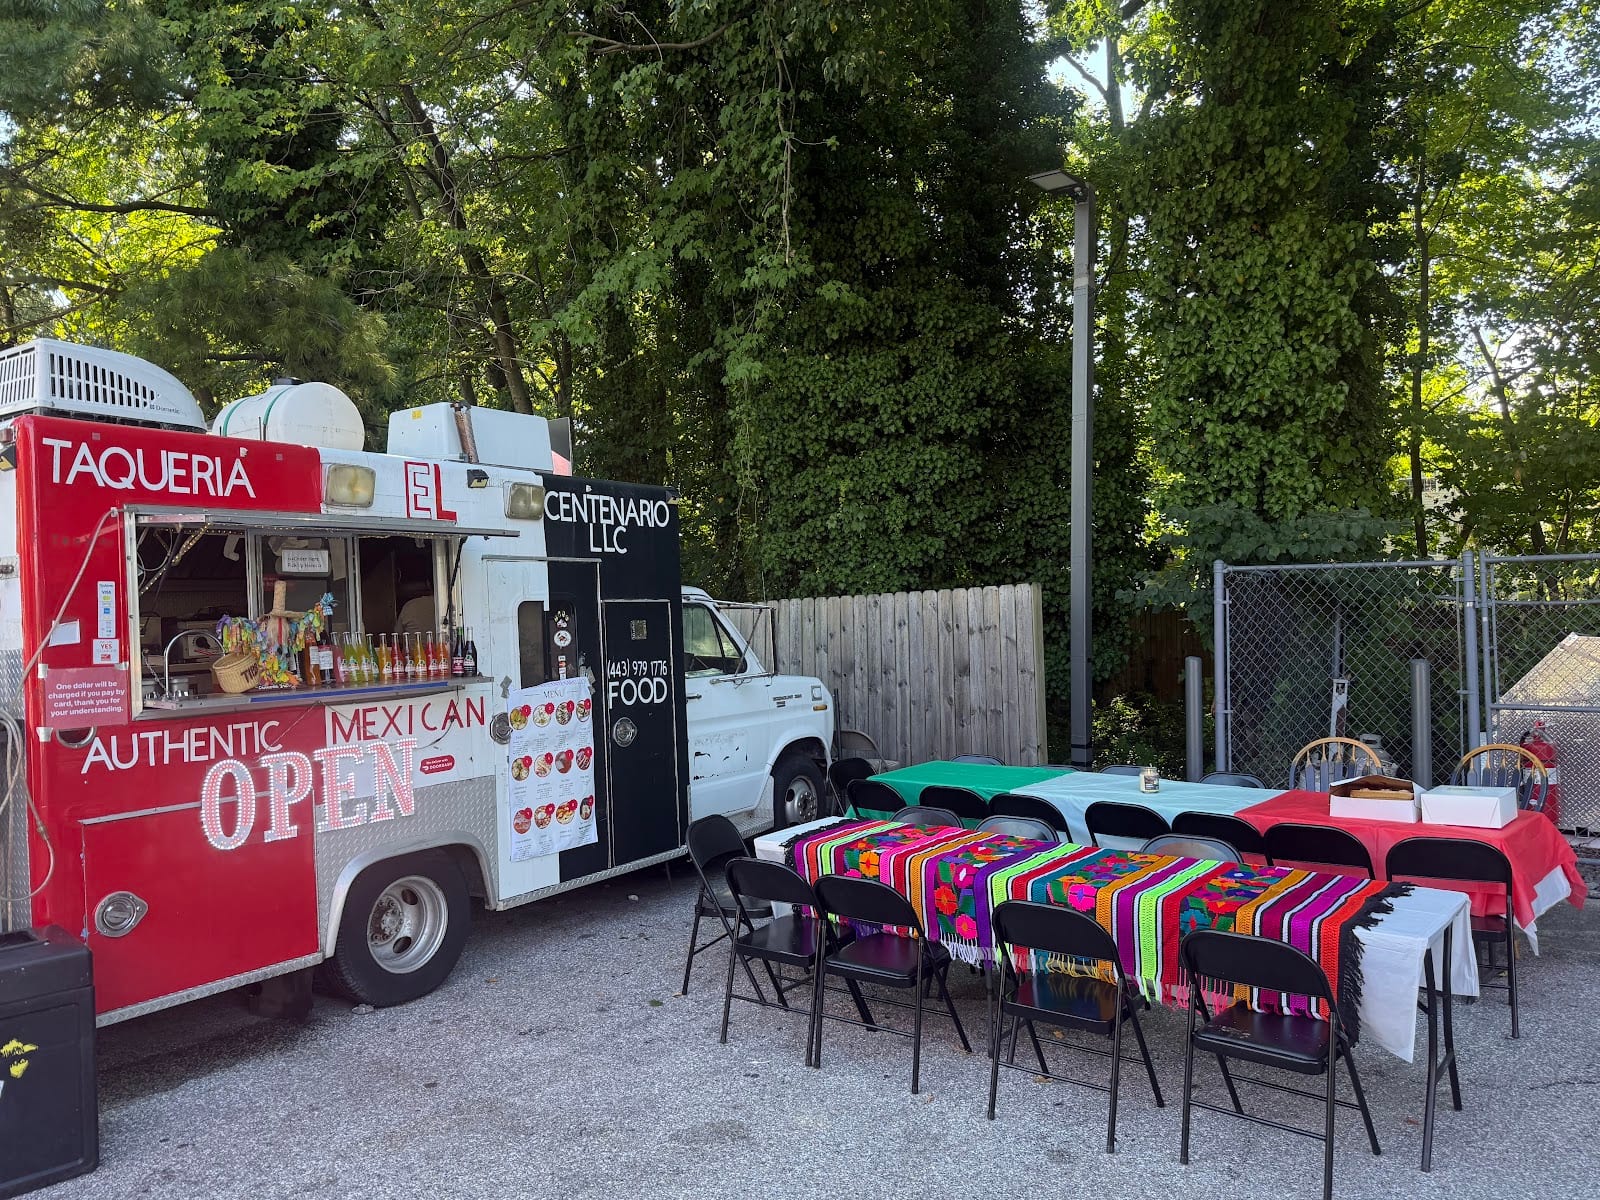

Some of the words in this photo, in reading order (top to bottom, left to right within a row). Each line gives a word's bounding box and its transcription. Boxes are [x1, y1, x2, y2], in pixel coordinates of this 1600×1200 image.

[404, 461, 458, 521] EL
[544, 490, 670, 528] CENTENARIO
[588, 523, 628, 554] LLC
[95, 680, 107, 688] will
[607, 658, 630, 679] (443)
[632, 661, 648, 676] 979
[650, 660, 668, 676] 1776
[48, 691, 80, 700] charged
[87, 691, 100, 699] you
[101, 689, 114, 697] pay
[53, 700, 73, 708] card,
[74, 699, 94, 707] thank
[543, 690, 564, 698] MENU
[608, 677, 668, 710] FOOD
[50, 710, 68, 718] your
[69, 706, 124, 715] understanding.
[331, 697, 486, 745] MEXICAN
[81, 720, 284, 775] AUTHENTIC
[201, 737, 419, 851] OPEN
